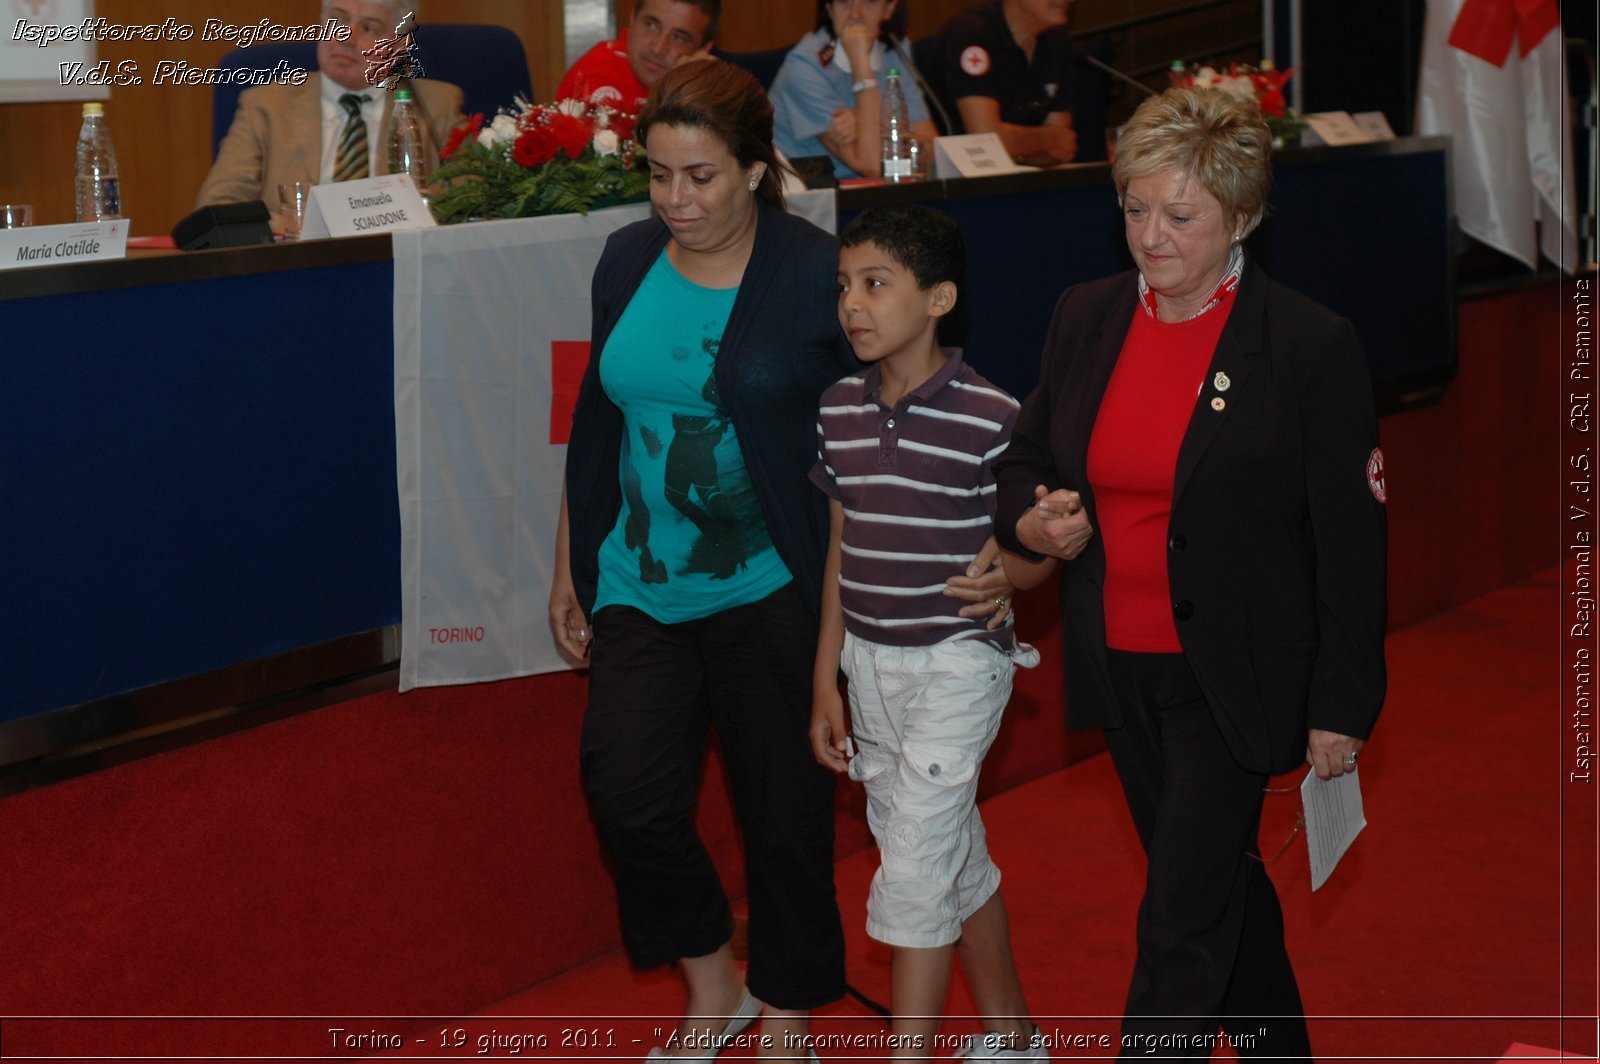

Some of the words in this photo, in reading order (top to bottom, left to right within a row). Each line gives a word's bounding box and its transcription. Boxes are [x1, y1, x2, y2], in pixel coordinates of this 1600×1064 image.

[348, 191, 393, 210] Emanuela
[352, 209, 408, 231] SCIAUDONE
[16, 243, 52, 261] Maria
[55, 239, 100, 257] Clotilde
[429, 626, 485, 644] TORINO
